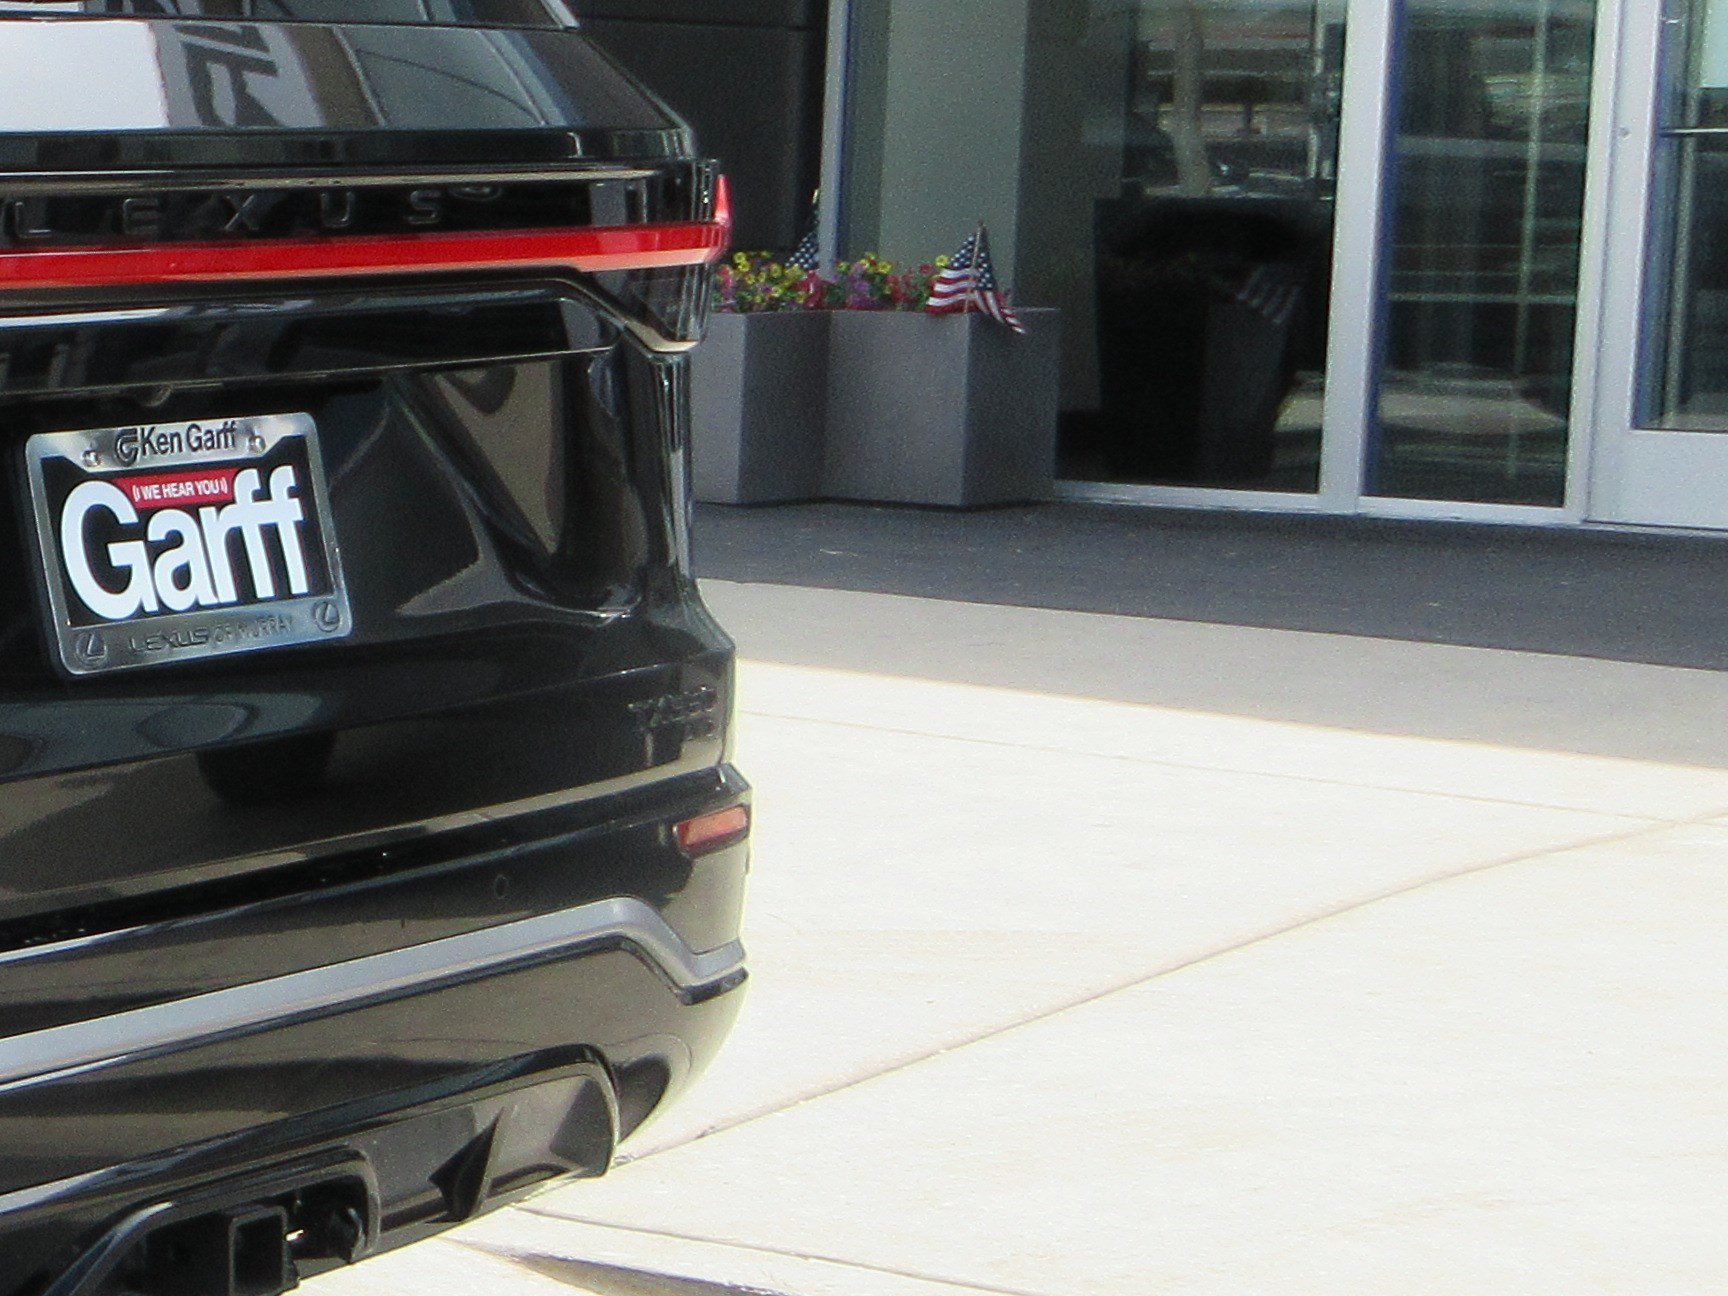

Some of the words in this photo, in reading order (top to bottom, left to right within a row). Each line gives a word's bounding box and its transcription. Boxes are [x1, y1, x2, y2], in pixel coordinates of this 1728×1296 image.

[12, 189, 442, 240] LEXUS
[141, 425, 183, 456] Ken
[186, 421, 237, 452] Garff
[143, 485, 161, 501] WE
[162, 481, 195, 498] HEAR
[195, 479, 220, 496] YOU
[61, 465, 309, 620] Garff
[129, 626, 210, 653] LEXUS
